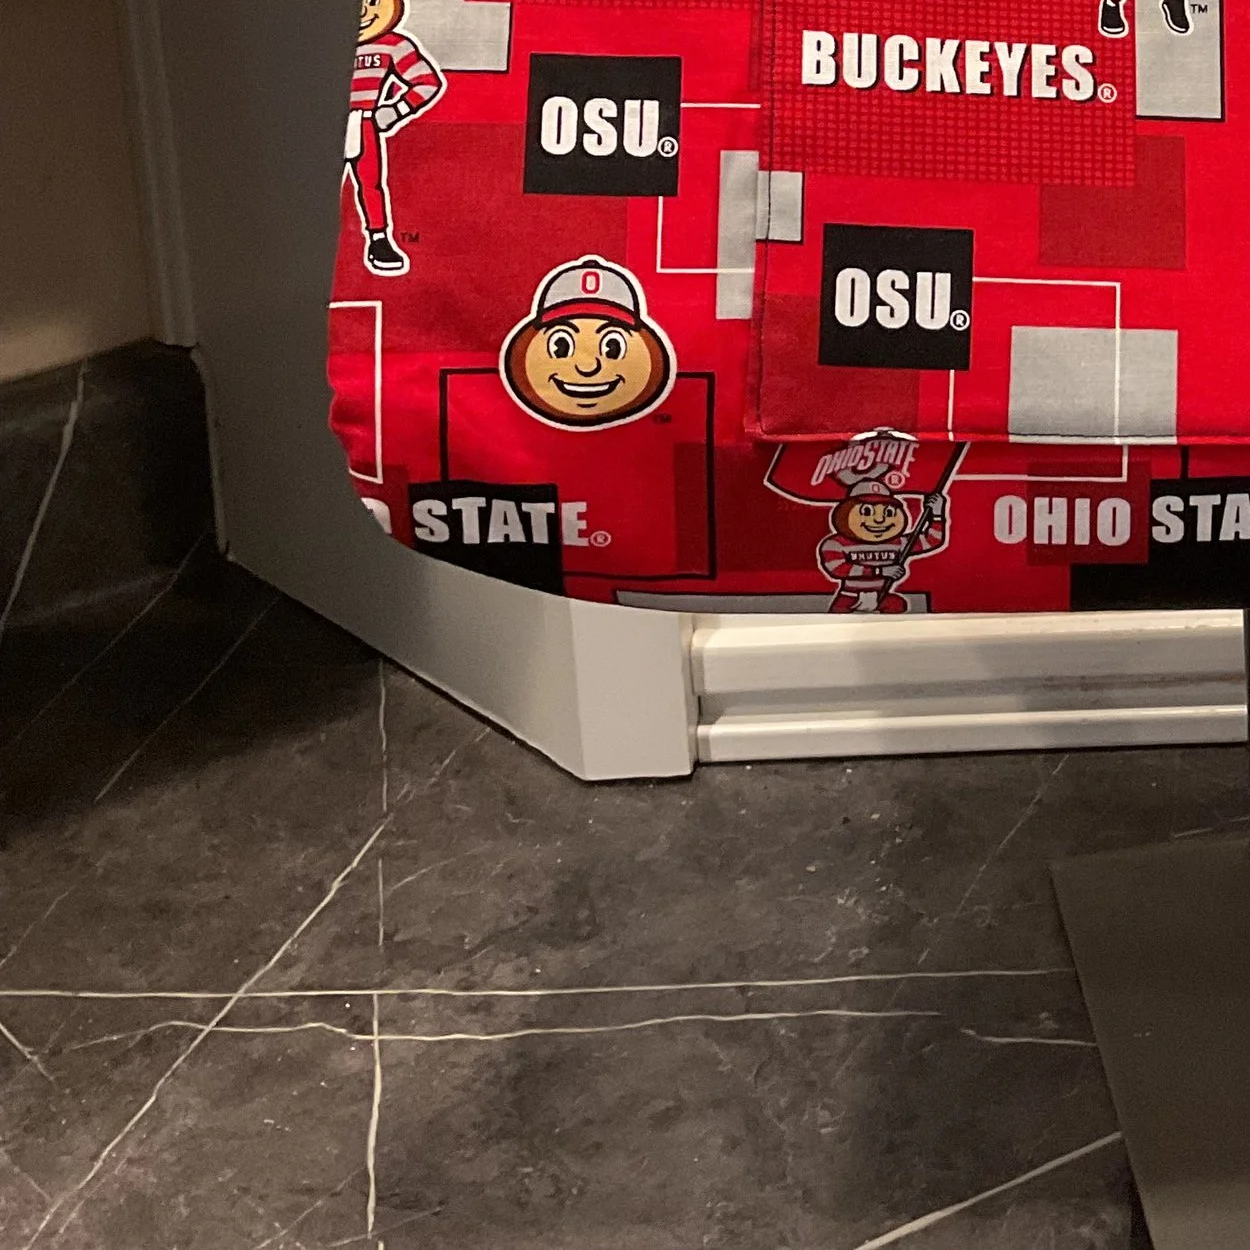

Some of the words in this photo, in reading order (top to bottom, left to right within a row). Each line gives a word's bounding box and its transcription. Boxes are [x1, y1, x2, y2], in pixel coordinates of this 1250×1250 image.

[1190, 4, 1208, 14] TM
[802, 30, 1093, 100] BUCKEYES
[541, 97, 659, 157] OSU
[835, 268, 951, 329] OSU
[413, 497, 588, 546] STATE
[994, 495, 1130, 545] OHIO
